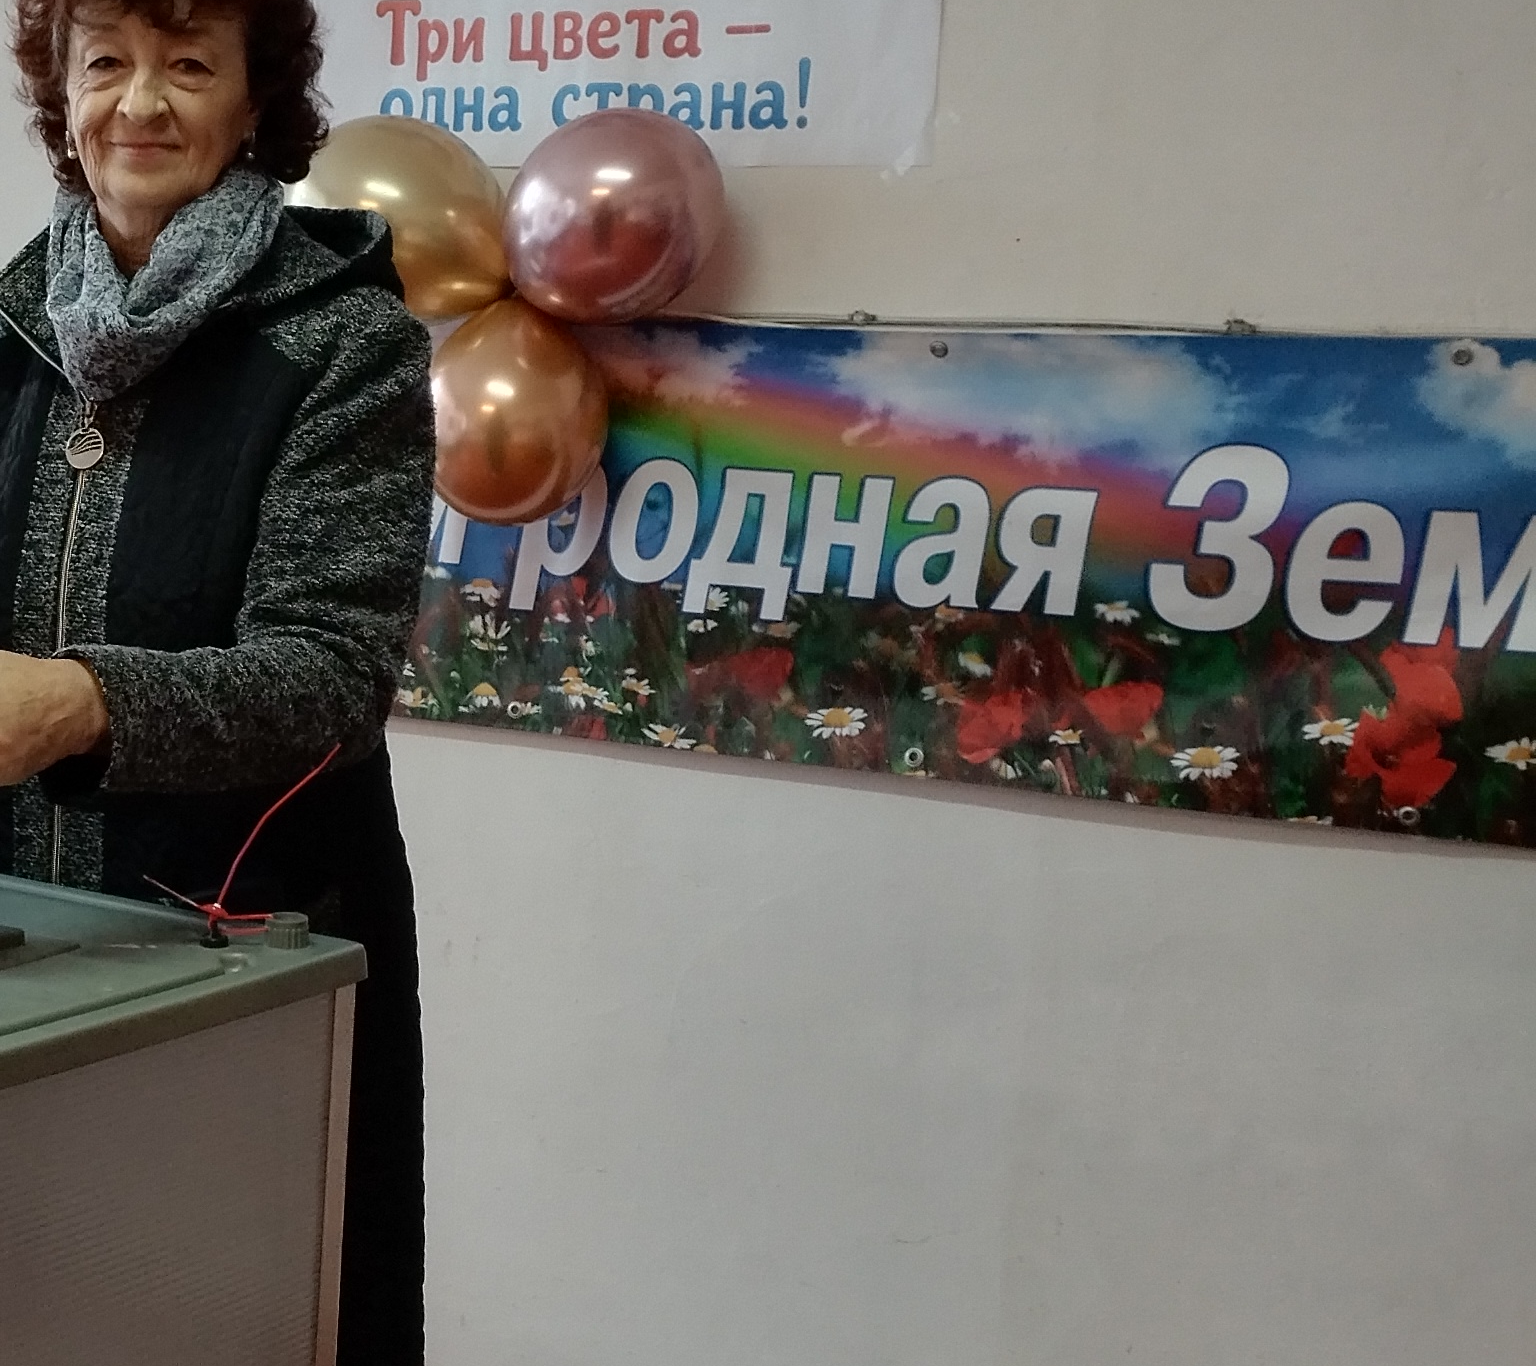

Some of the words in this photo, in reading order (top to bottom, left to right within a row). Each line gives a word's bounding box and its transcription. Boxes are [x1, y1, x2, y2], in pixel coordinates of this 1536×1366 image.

[507, 8, 703, 72] цвета
[379, 84, 522, 133] одна
[508, 455, 1099, 622] родная
[1147, 442, 1536, 654] Зем
